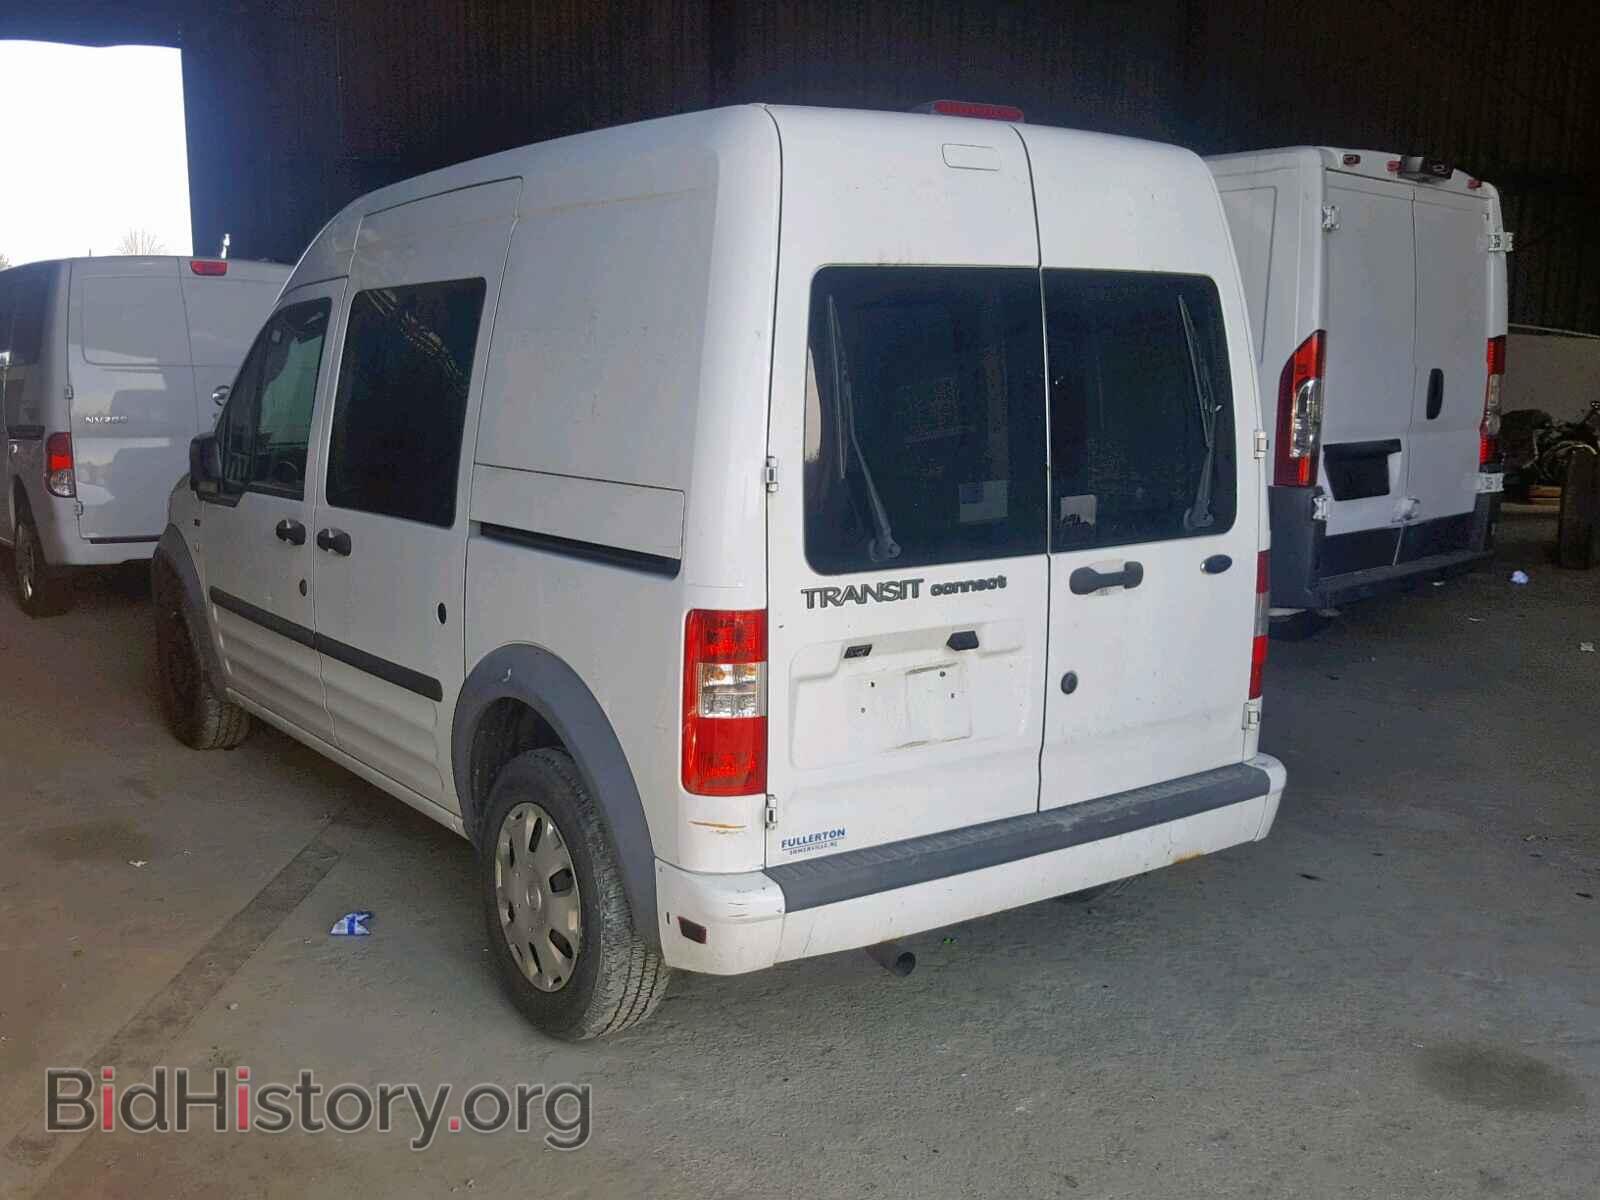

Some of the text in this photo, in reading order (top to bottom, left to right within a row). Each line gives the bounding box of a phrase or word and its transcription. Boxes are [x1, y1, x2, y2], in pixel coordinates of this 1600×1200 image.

[801, 575, 1007, 609] TRANSIT connect
[781, 828, 846, 849] FULLERTON
